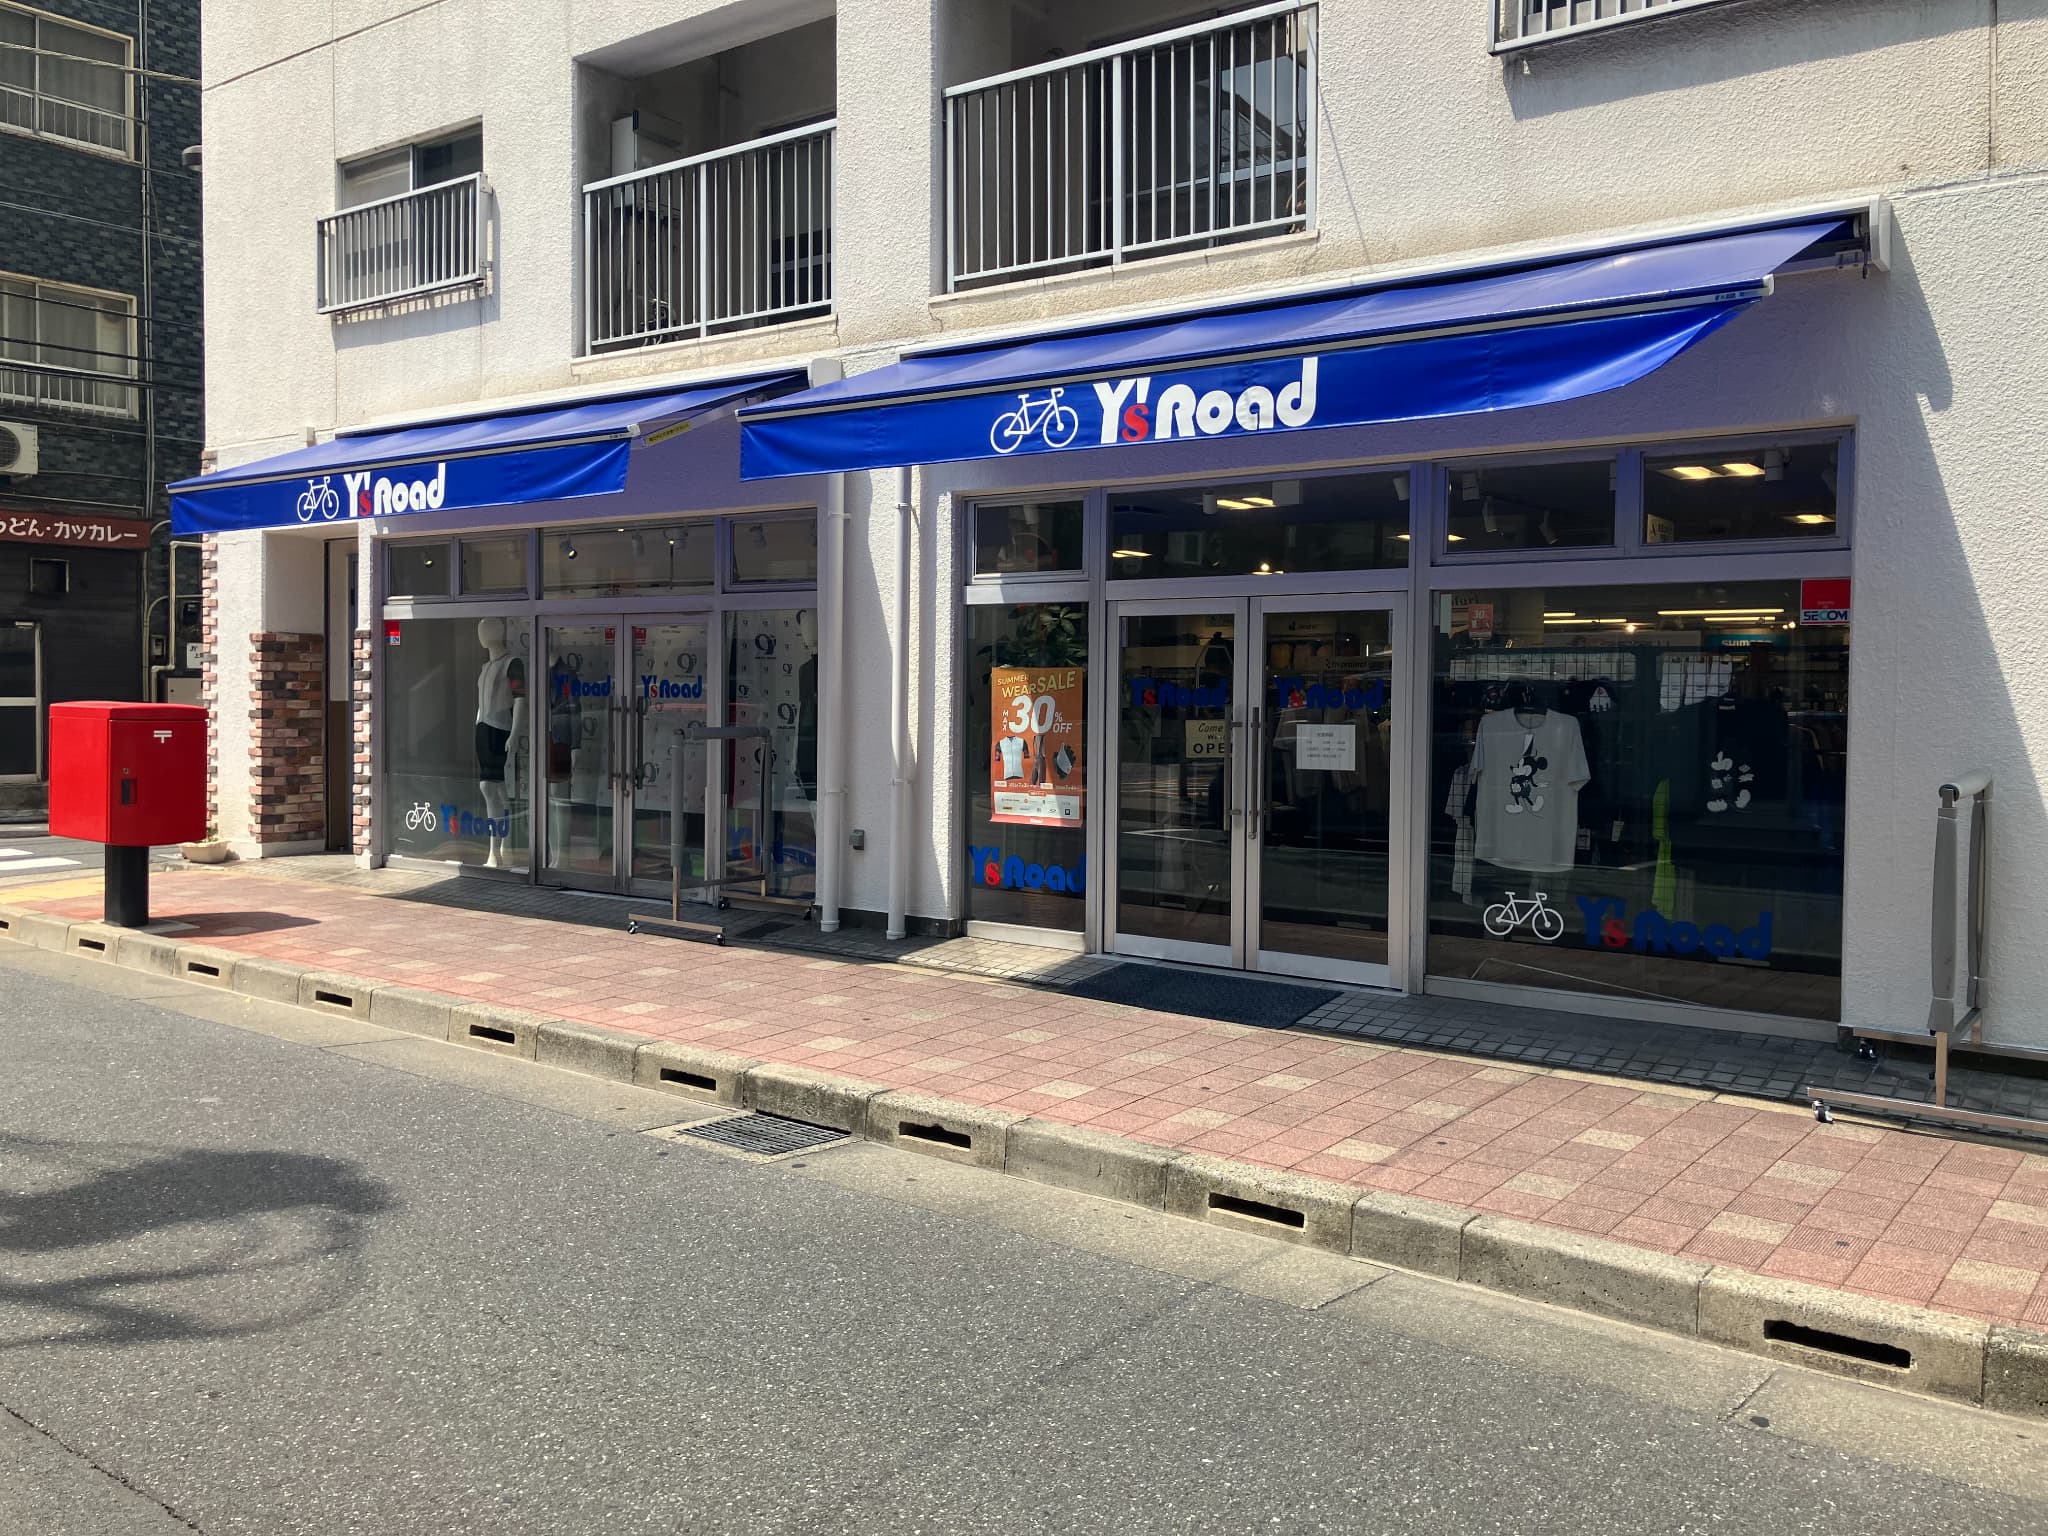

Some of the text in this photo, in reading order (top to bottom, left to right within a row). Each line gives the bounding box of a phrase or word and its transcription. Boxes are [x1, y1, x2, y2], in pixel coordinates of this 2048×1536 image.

[1093, 357, 1318, 444] Y's Road
[343, 462, 446, 517] Y's Road
[1803, 610, 1848, 621] SECOM
[571, 673, 611, 697] Road
[641, 674, 703, 699] Y's Road
[997, 673, 1029, 686] SUMMER
[1001, 671, 1076, 698] WEAR SALE
[1157, 676, 1228, 708] Road
[1306, 676, 1385, 709] Road
[1009, 695, 1056, 734] 30
[1053, 722, 1073, 734] OFF
[1198, 722, 1223, 733] Come
[1193, 743, 1231, 754] OPE
[460, 808, 510, 838] Road
[968, 846, 1086, 893] Y's Road
[1576, 896, 1773, 961] Y's Road
